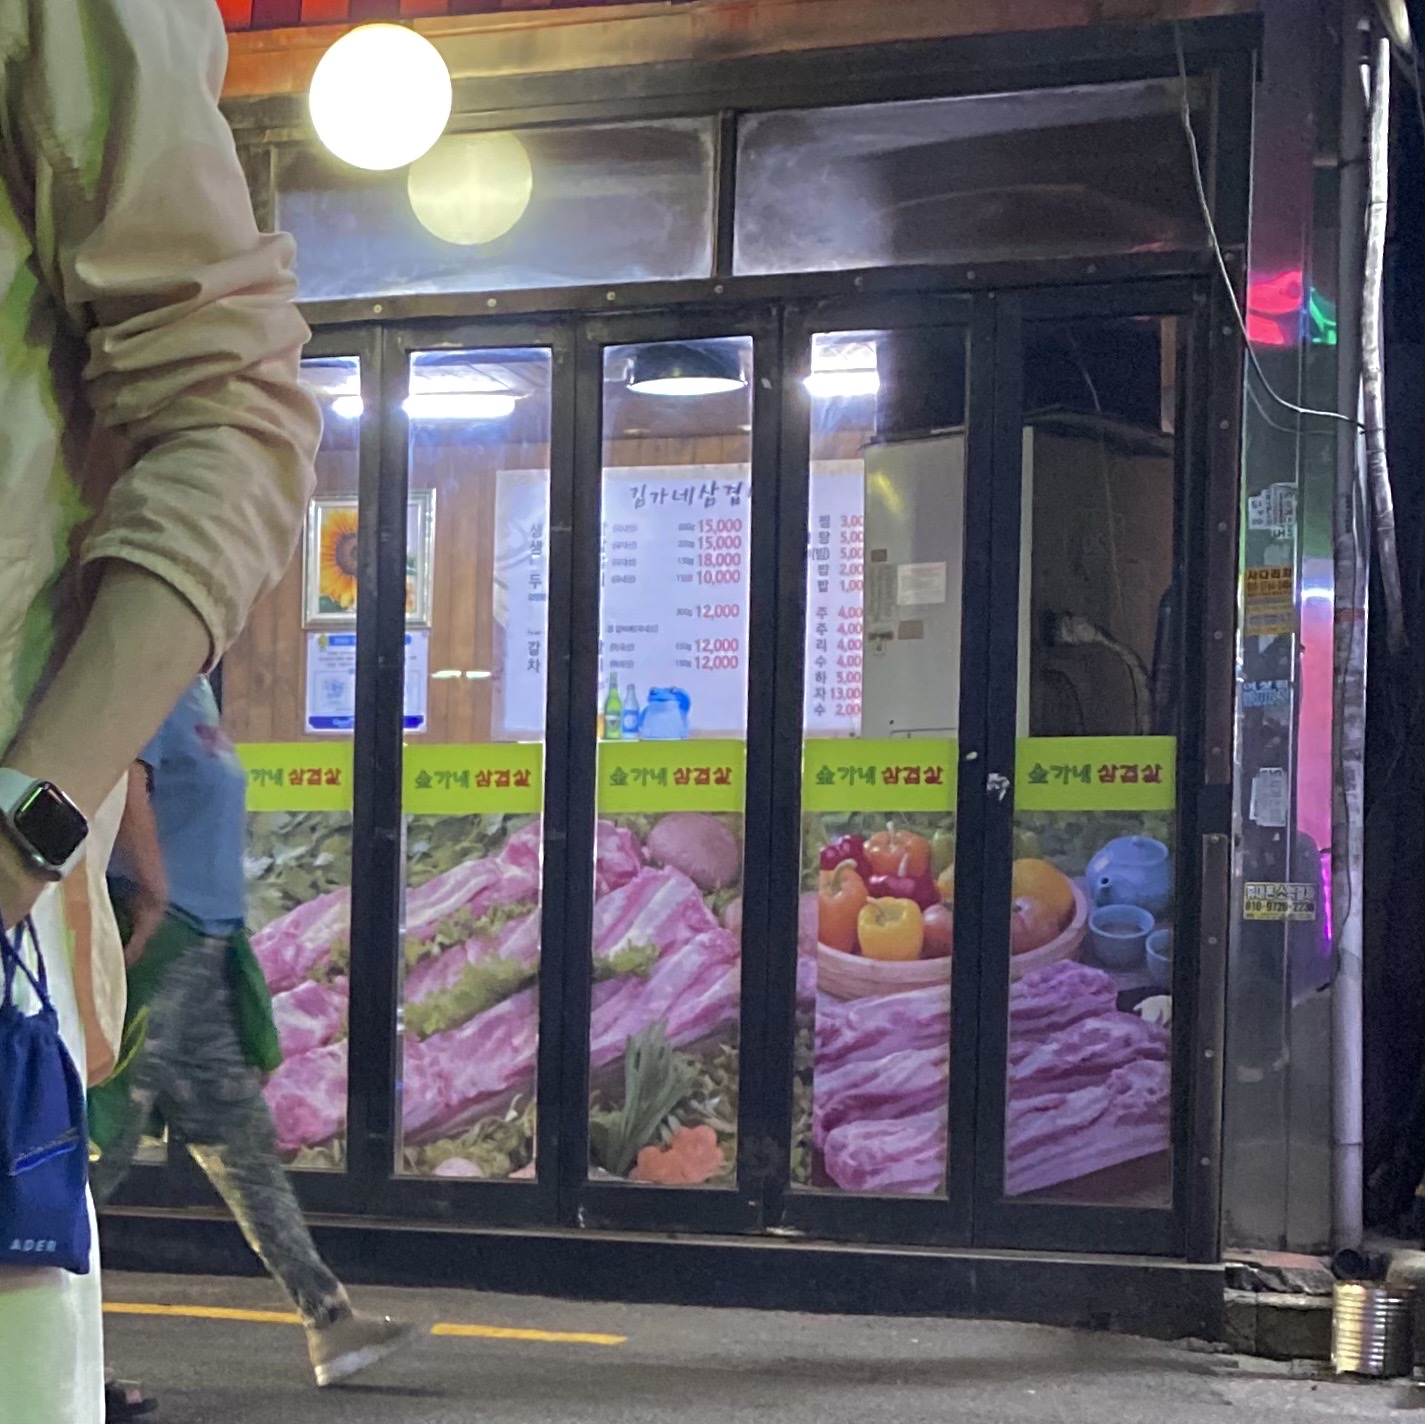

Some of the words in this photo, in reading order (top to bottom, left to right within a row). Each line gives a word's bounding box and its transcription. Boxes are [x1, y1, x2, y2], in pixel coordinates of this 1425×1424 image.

[629, 480, 752, 510] 김가네삼겹
[698, 518, 743, 534] 15,000
[698, 535, 742, 551] 15,000
[697, 552, 742, 568] 18,000
[696, 569, 741, 585] 10,000
[695, 604, 740, 620] 12,000
[694, 638, 739, 654] 12,000
[694, 655, 739, 671] 12,000
[247, 768, 283, 787] 가네
[287, 767, 342, 787] 삼겹살
[474, 769, 532, 788] 삼겹살
[672, 766, 733, 786] 삼겹살
[881, 765, 944, 786] 삼겹살
[1097, 763, 1163, 784] 삼겹살
[10, 1238, 57, 1253] ADER
